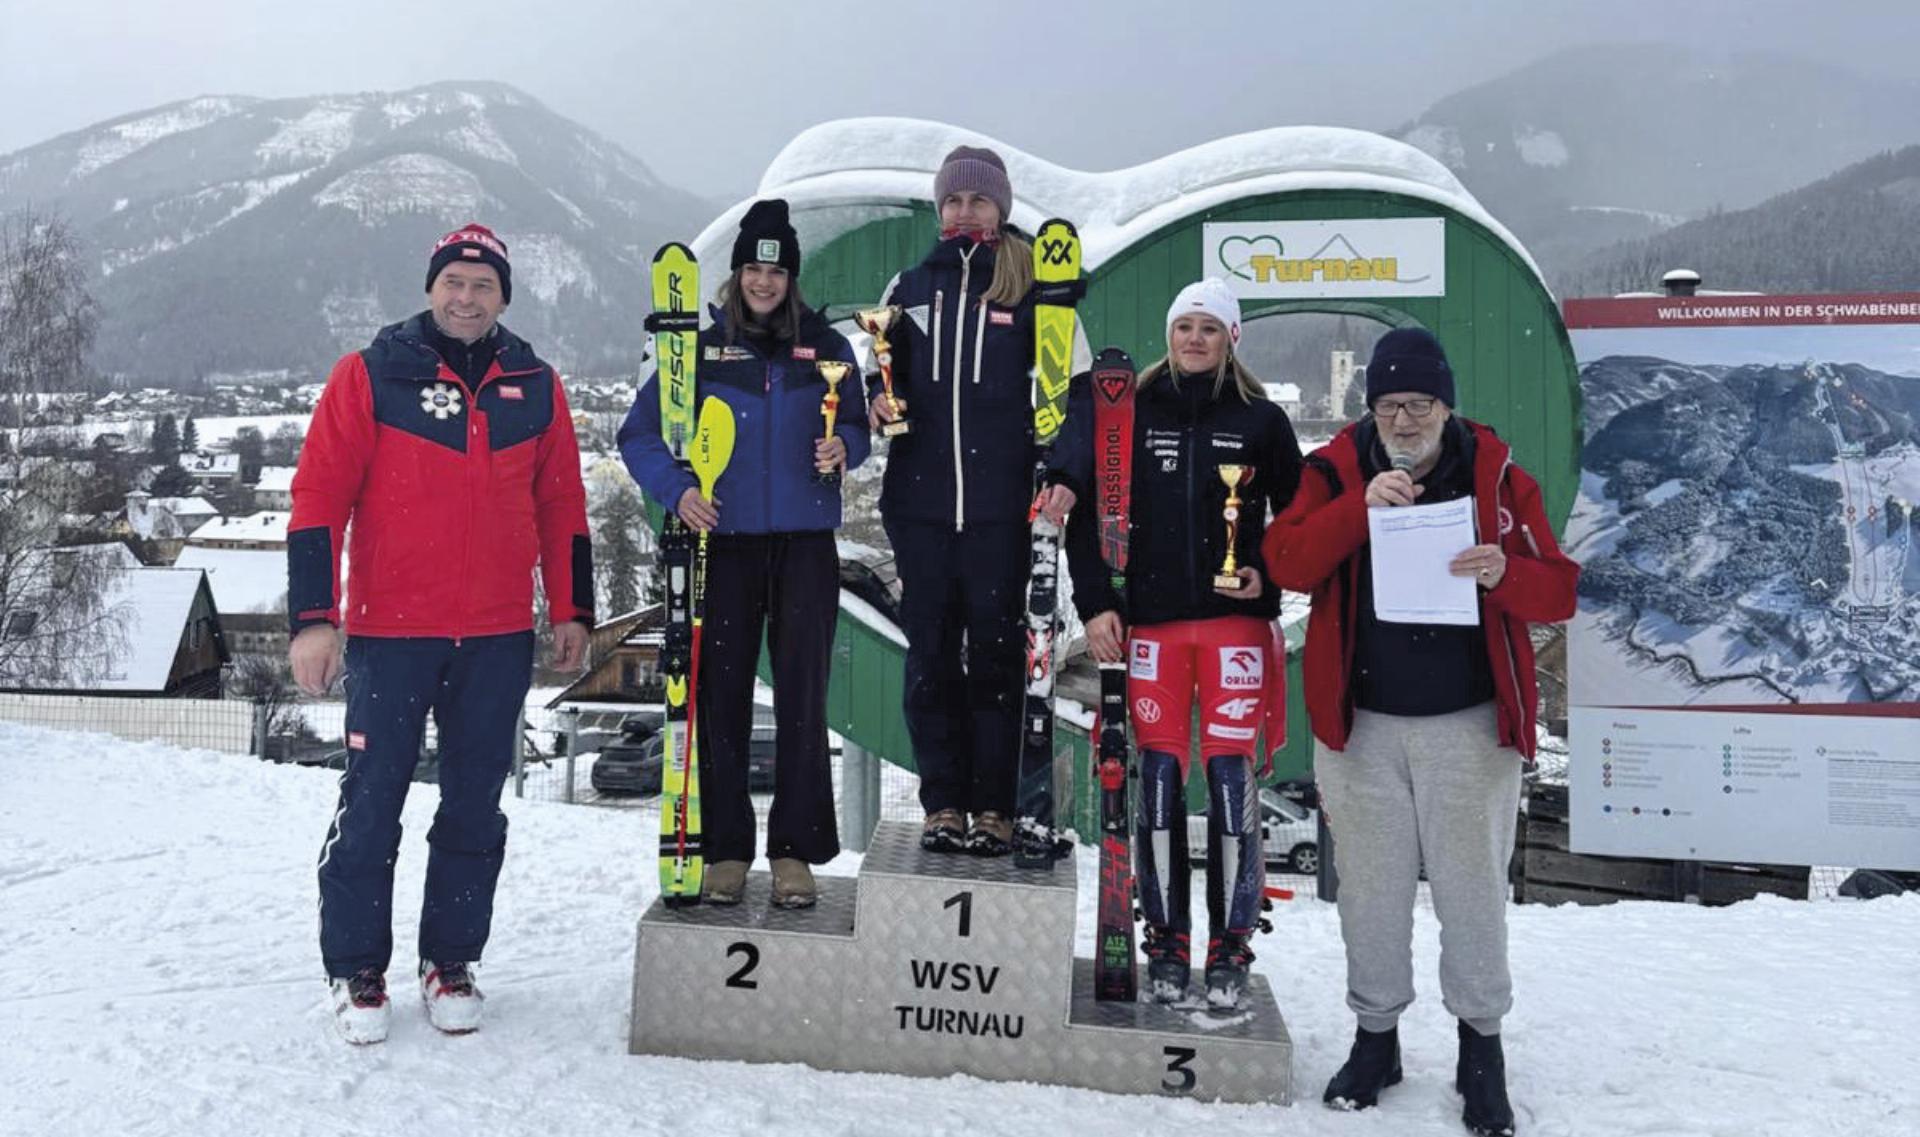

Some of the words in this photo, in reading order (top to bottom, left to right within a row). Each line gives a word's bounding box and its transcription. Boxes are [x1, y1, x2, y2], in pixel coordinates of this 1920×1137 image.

[1251, 256, 1397, 283] Turnau
[1658, 306, 1760, 319] WILLKOMMEN
[1764, 305, 1780, 317] IN
[1784, 305, 1813, 317] DER
[1816, 303, 1920, 316] SCHWABENBE
[669, 272, 685, 408] FISCER
[702, 427, 710, 464] LEKI
[1106, 425, 1121, 516] ROSSIGNOL
[1224, 676, 1260, 685] ORLEN
[1216, 698, 1260, 720] 4F
[943, 891, 972, 937] 1
[725, 941, 761, 990] 2
[911, 959, 1000, 994] WSV
[895, 1005, 1024, 1039] TURNAU
[1161, 1045, 1197, 1092] 3
